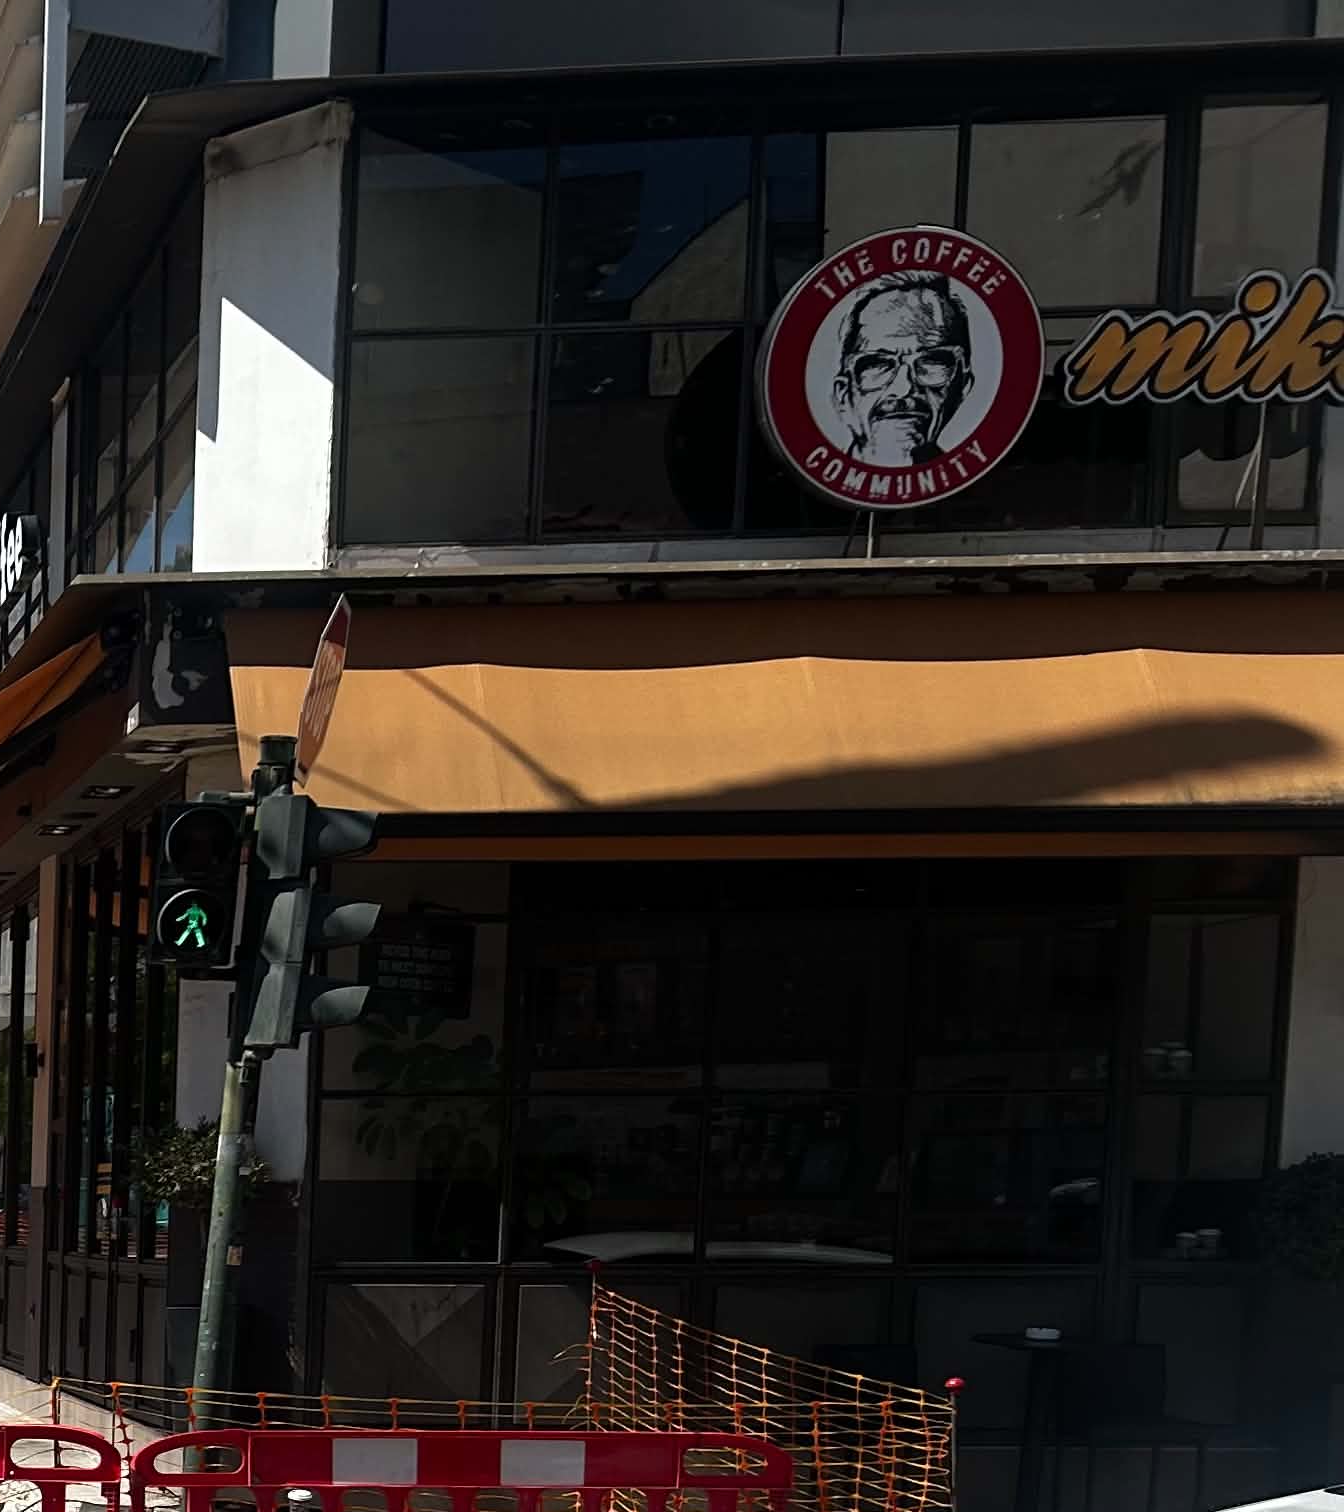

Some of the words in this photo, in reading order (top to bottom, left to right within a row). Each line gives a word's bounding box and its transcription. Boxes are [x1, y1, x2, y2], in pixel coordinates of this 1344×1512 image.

[814, 249, 875, 300] THE
[891, 237, 1008, 296] COFFEE
[1066, 270, 1344, 402] mik
[805, 439, 988, 500] COMMUNITY
